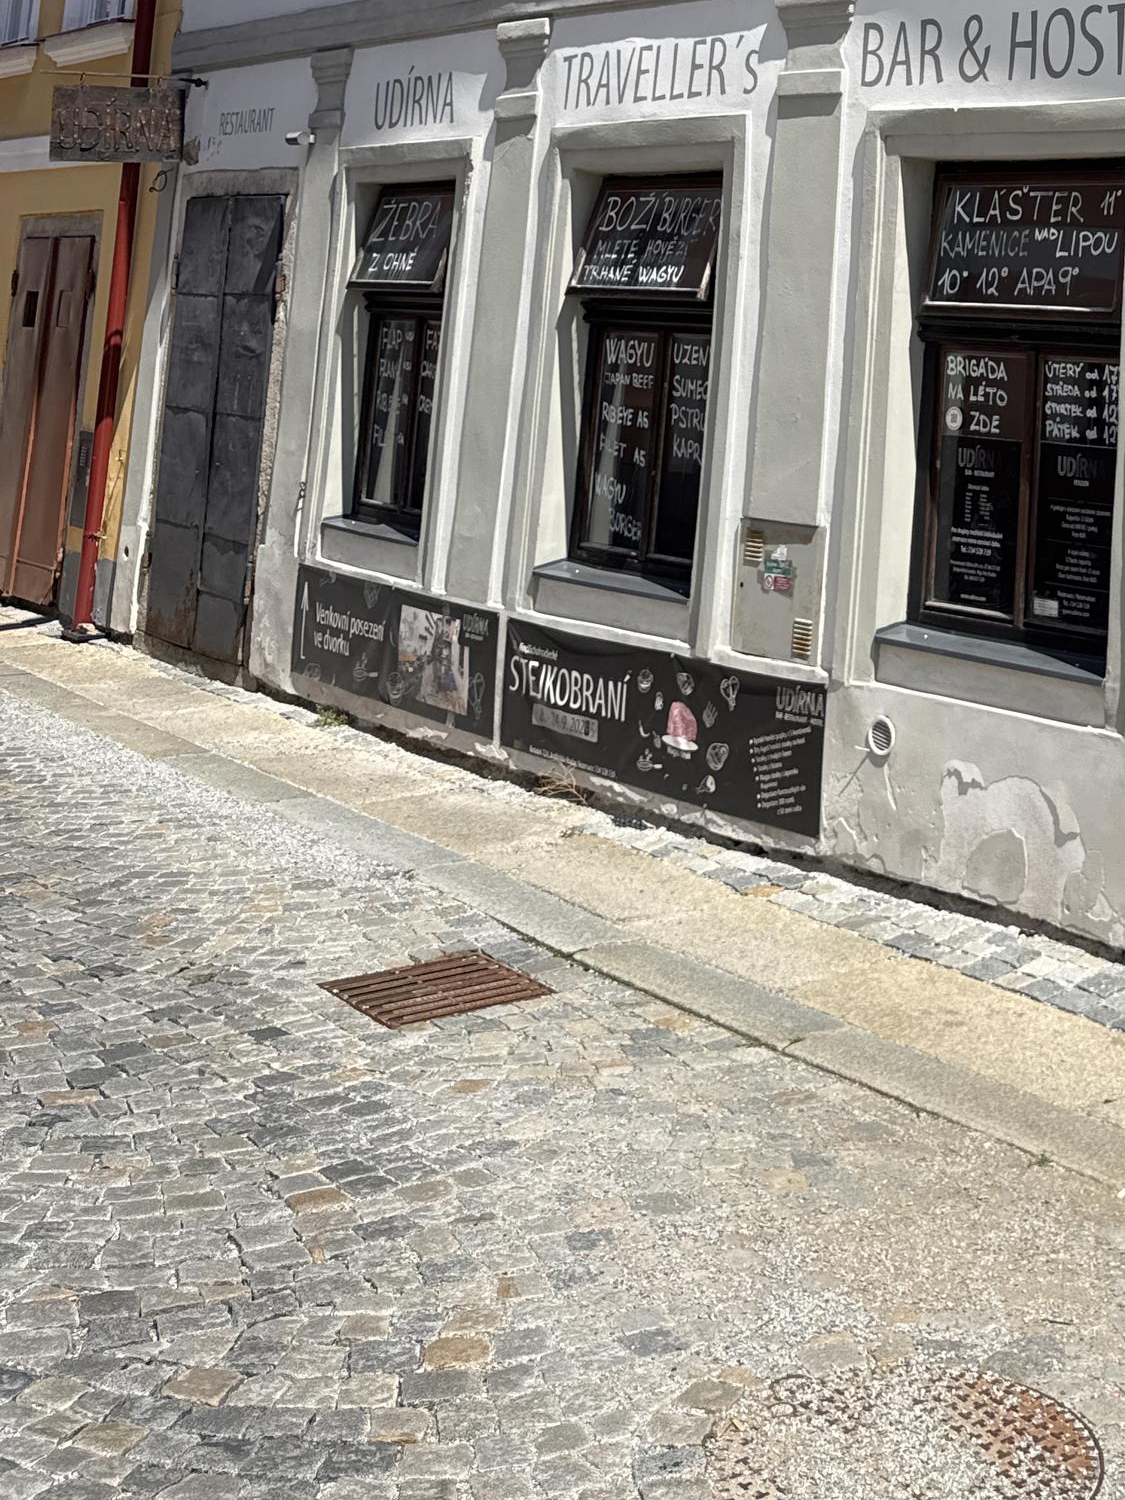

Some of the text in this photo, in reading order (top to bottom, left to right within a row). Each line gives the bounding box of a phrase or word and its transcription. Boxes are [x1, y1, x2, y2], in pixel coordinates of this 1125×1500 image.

[861, 17, 945, 89] BAR
[957, 14, 991, 84] &
[374, 64, 455, 131] UDÍRNA
[57, 96, 181, 153] UDÍRNA
[219, 107, 275, 137] RESTAURANT
[953, 185, 1084, 225] KLÁŠTER
[940, 227, 1118, 259] KAMENICE NAD LIPOU
[367, 252, 381, 272] Z
[638, 264, 685, 283] WAGYU
[605, 337, 655, 368] WAGYU
[604, 371, 654, 390] JAPAN BEEF
[946, 355, 1008, 382] BRIGÁDA
[1085, 368, 1100, 381] od
[947, 380, 1009, 407] NA LÉTO
[1083, 385, 1098, 399] od
[968, 410, 1001, 434] ZDE
[315, 601, 386, 643] Venkovní posezení
[313, 629, 350, 657] ve dvorku
[508, 654, 631, 723] STEJKOBRANÍ
[775, 684, 825, 718] UDÍRNA
